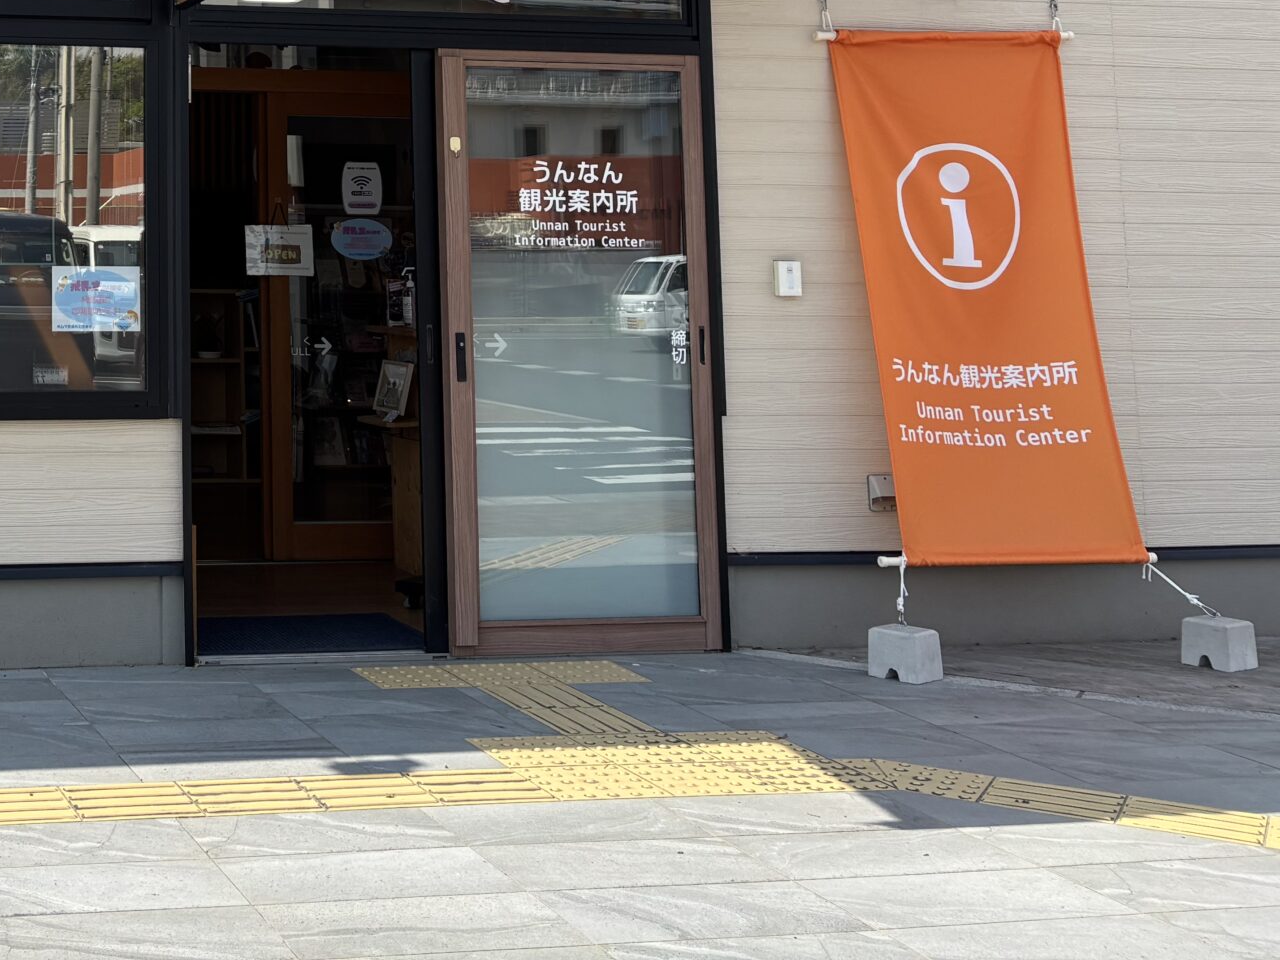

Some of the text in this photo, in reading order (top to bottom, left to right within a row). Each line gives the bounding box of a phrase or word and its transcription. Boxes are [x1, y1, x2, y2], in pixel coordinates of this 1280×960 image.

[533, 160, 623, 184] うんなん
[518, 187, 639, 214] 観光案内所
[531, 220, 626, 232] Unnan Tourist
[514, 234, 646, 248] Information Center
[265, 248, 297, 260] OPEN
[291, 346, 311, 356] ULL
[671, 329, 687, 365] 締切
[892, 358, 1078, 389] うんなん観光案内所
[916, 401, 1054, 422] Unnan Tourist
[899, 424, 1092, 447] Information Center
